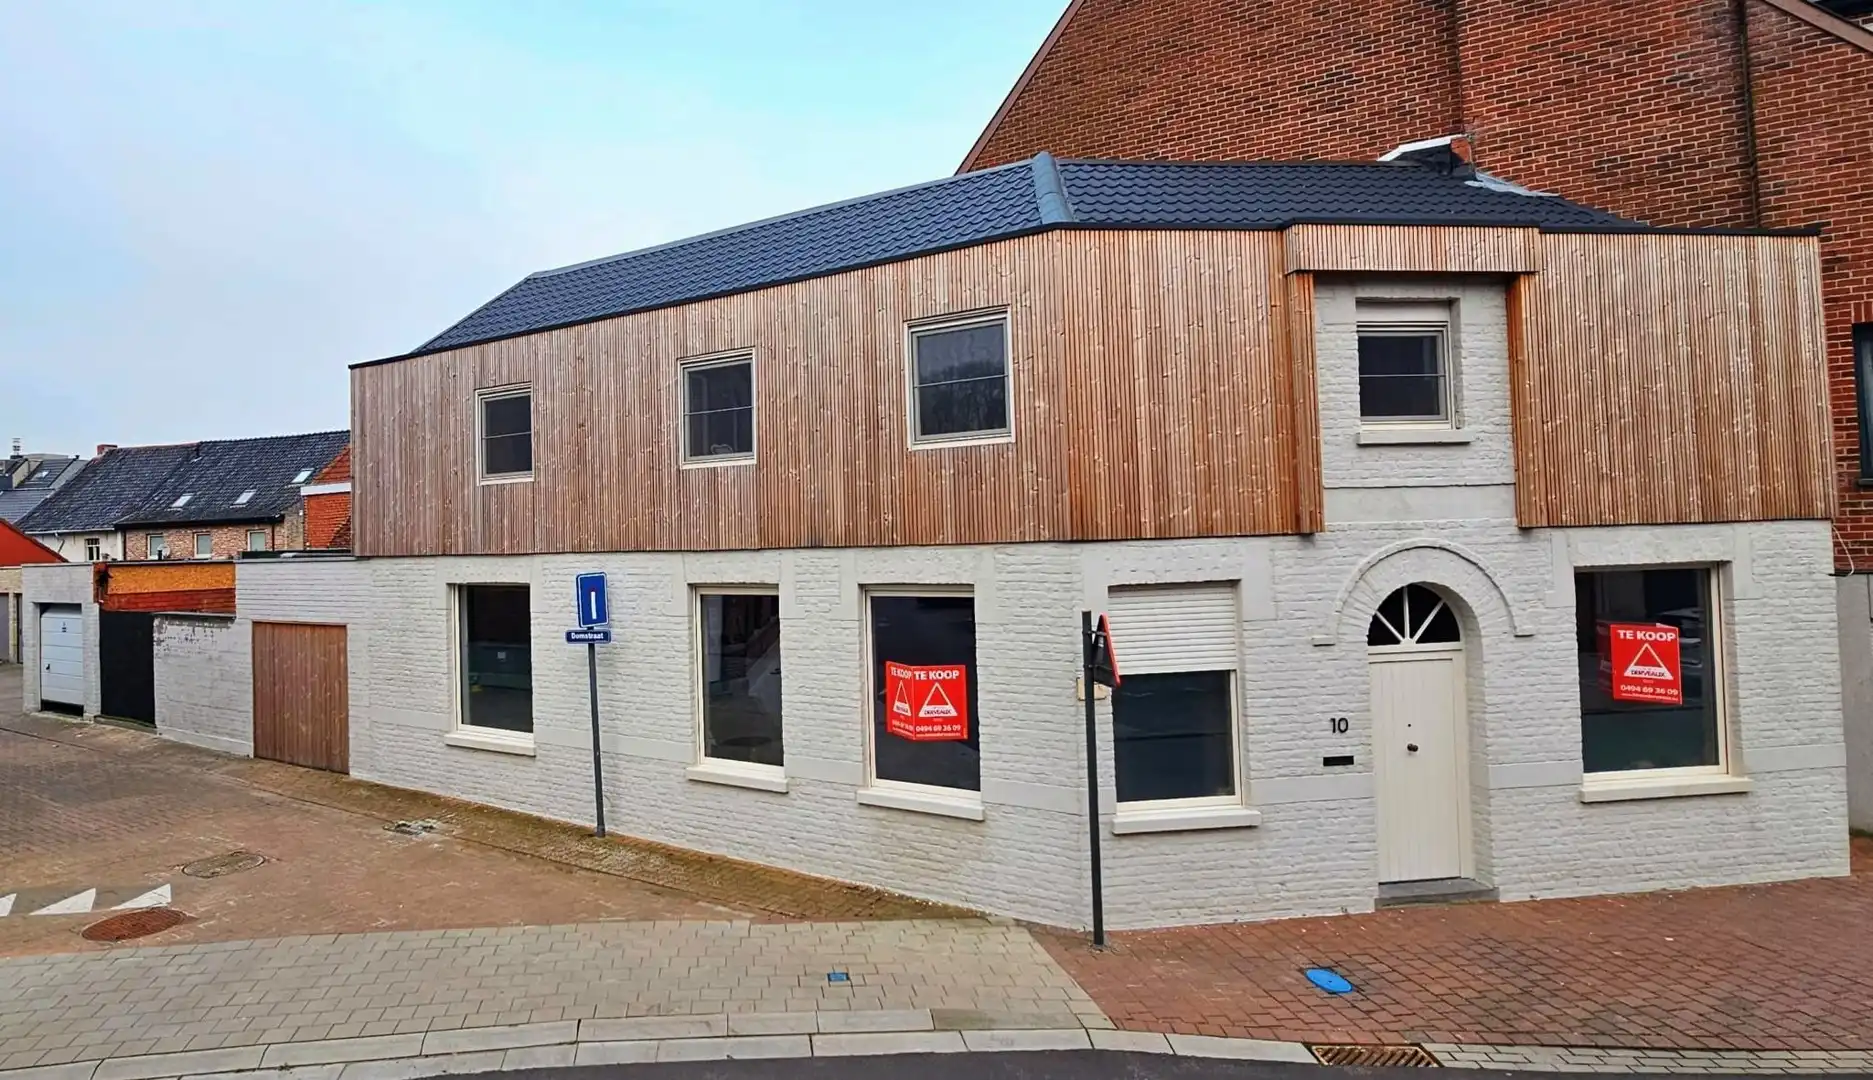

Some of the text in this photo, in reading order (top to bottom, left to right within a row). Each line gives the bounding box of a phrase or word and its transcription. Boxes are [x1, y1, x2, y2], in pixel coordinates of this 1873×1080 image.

[1617, 630, 1676, 642] TE KOOP
[914, 670, 960, 680] TE KOOP
[1620, 684, 1641, 692] 0494
[1642, 686, 1653, 694] 69
[1667, 688, 1679, 696] 09
[1330, 717, 1349, 733] 10
